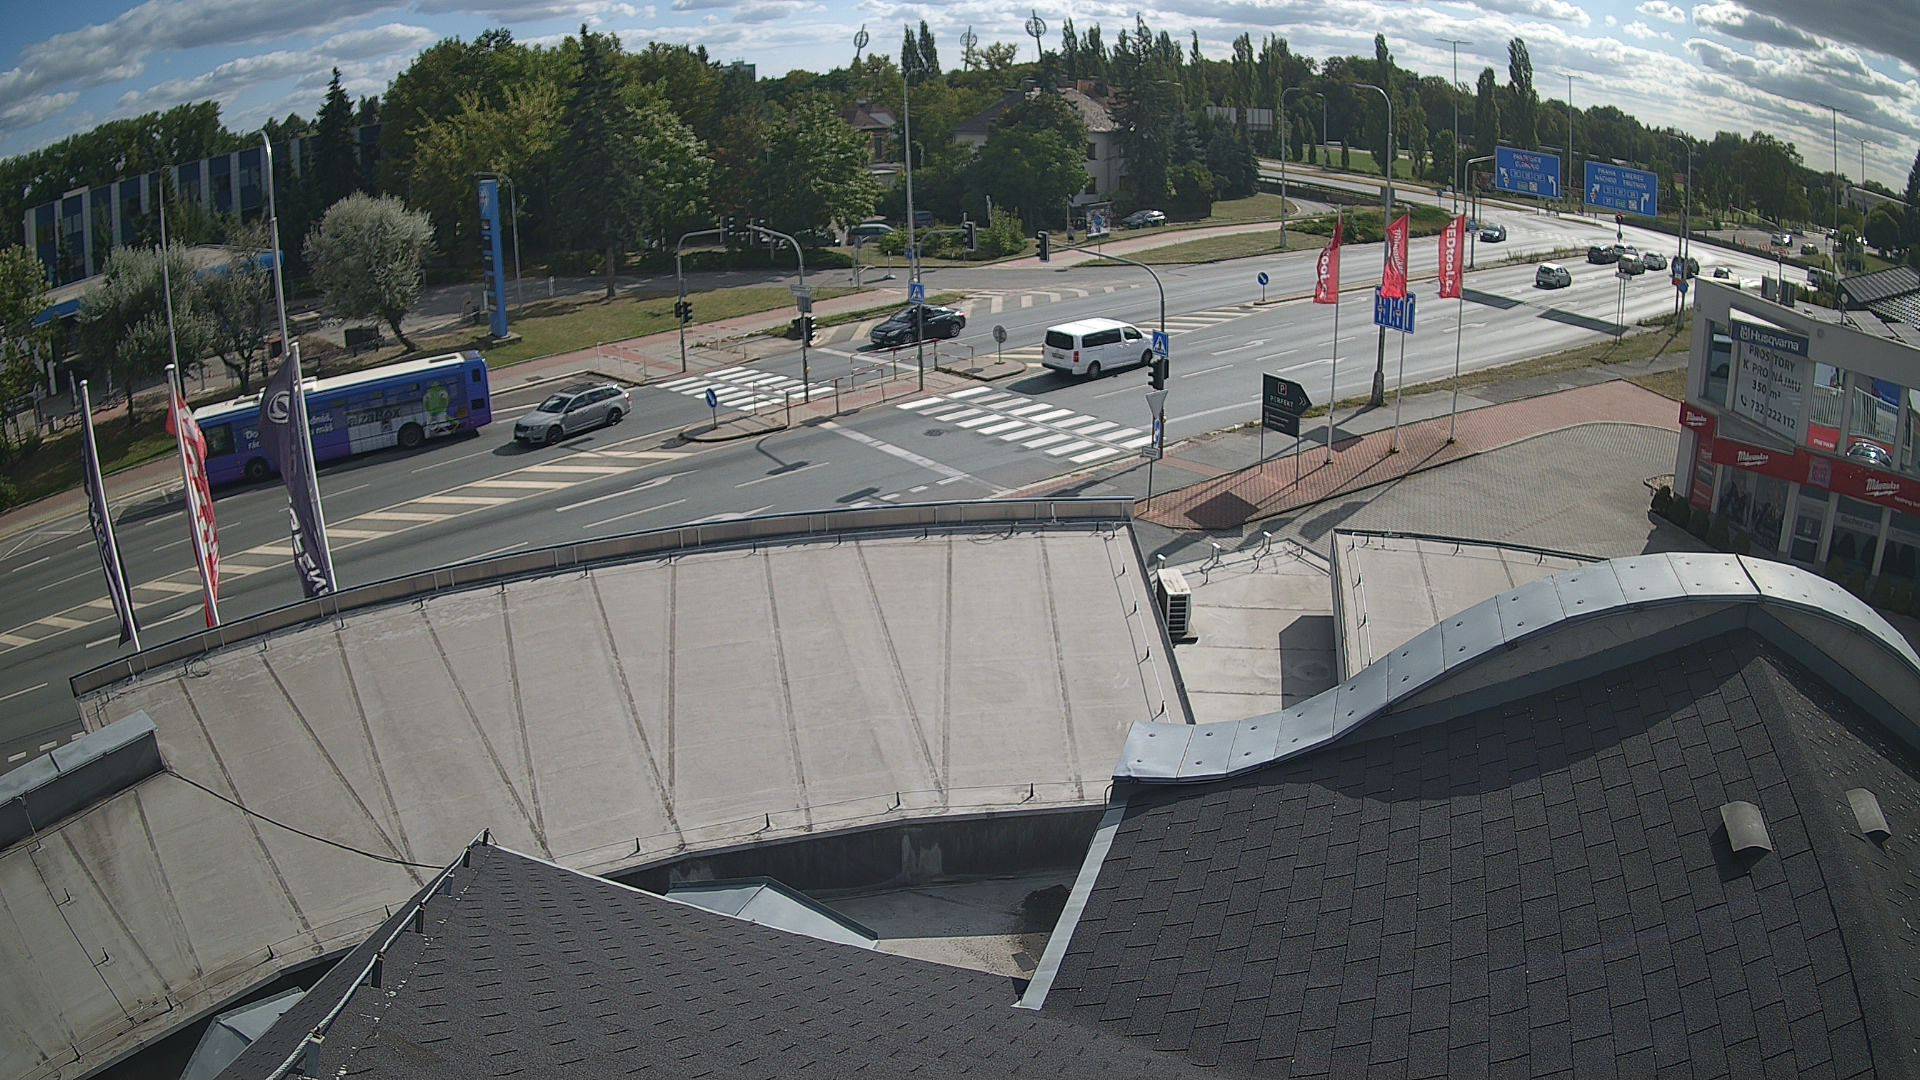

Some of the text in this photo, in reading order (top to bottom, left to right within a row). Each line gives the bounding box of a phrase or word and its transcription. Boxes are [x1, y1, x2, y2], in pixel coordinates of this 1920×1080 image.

[1749, 328, 1799, 352] Husqvarna
[1742, 359, 1749, 371] K
[1751, 379, 1767, 394] 350
[1269, 394, 1294, 409] PERFEKT
[1750, 399, 1765, 414] 732
